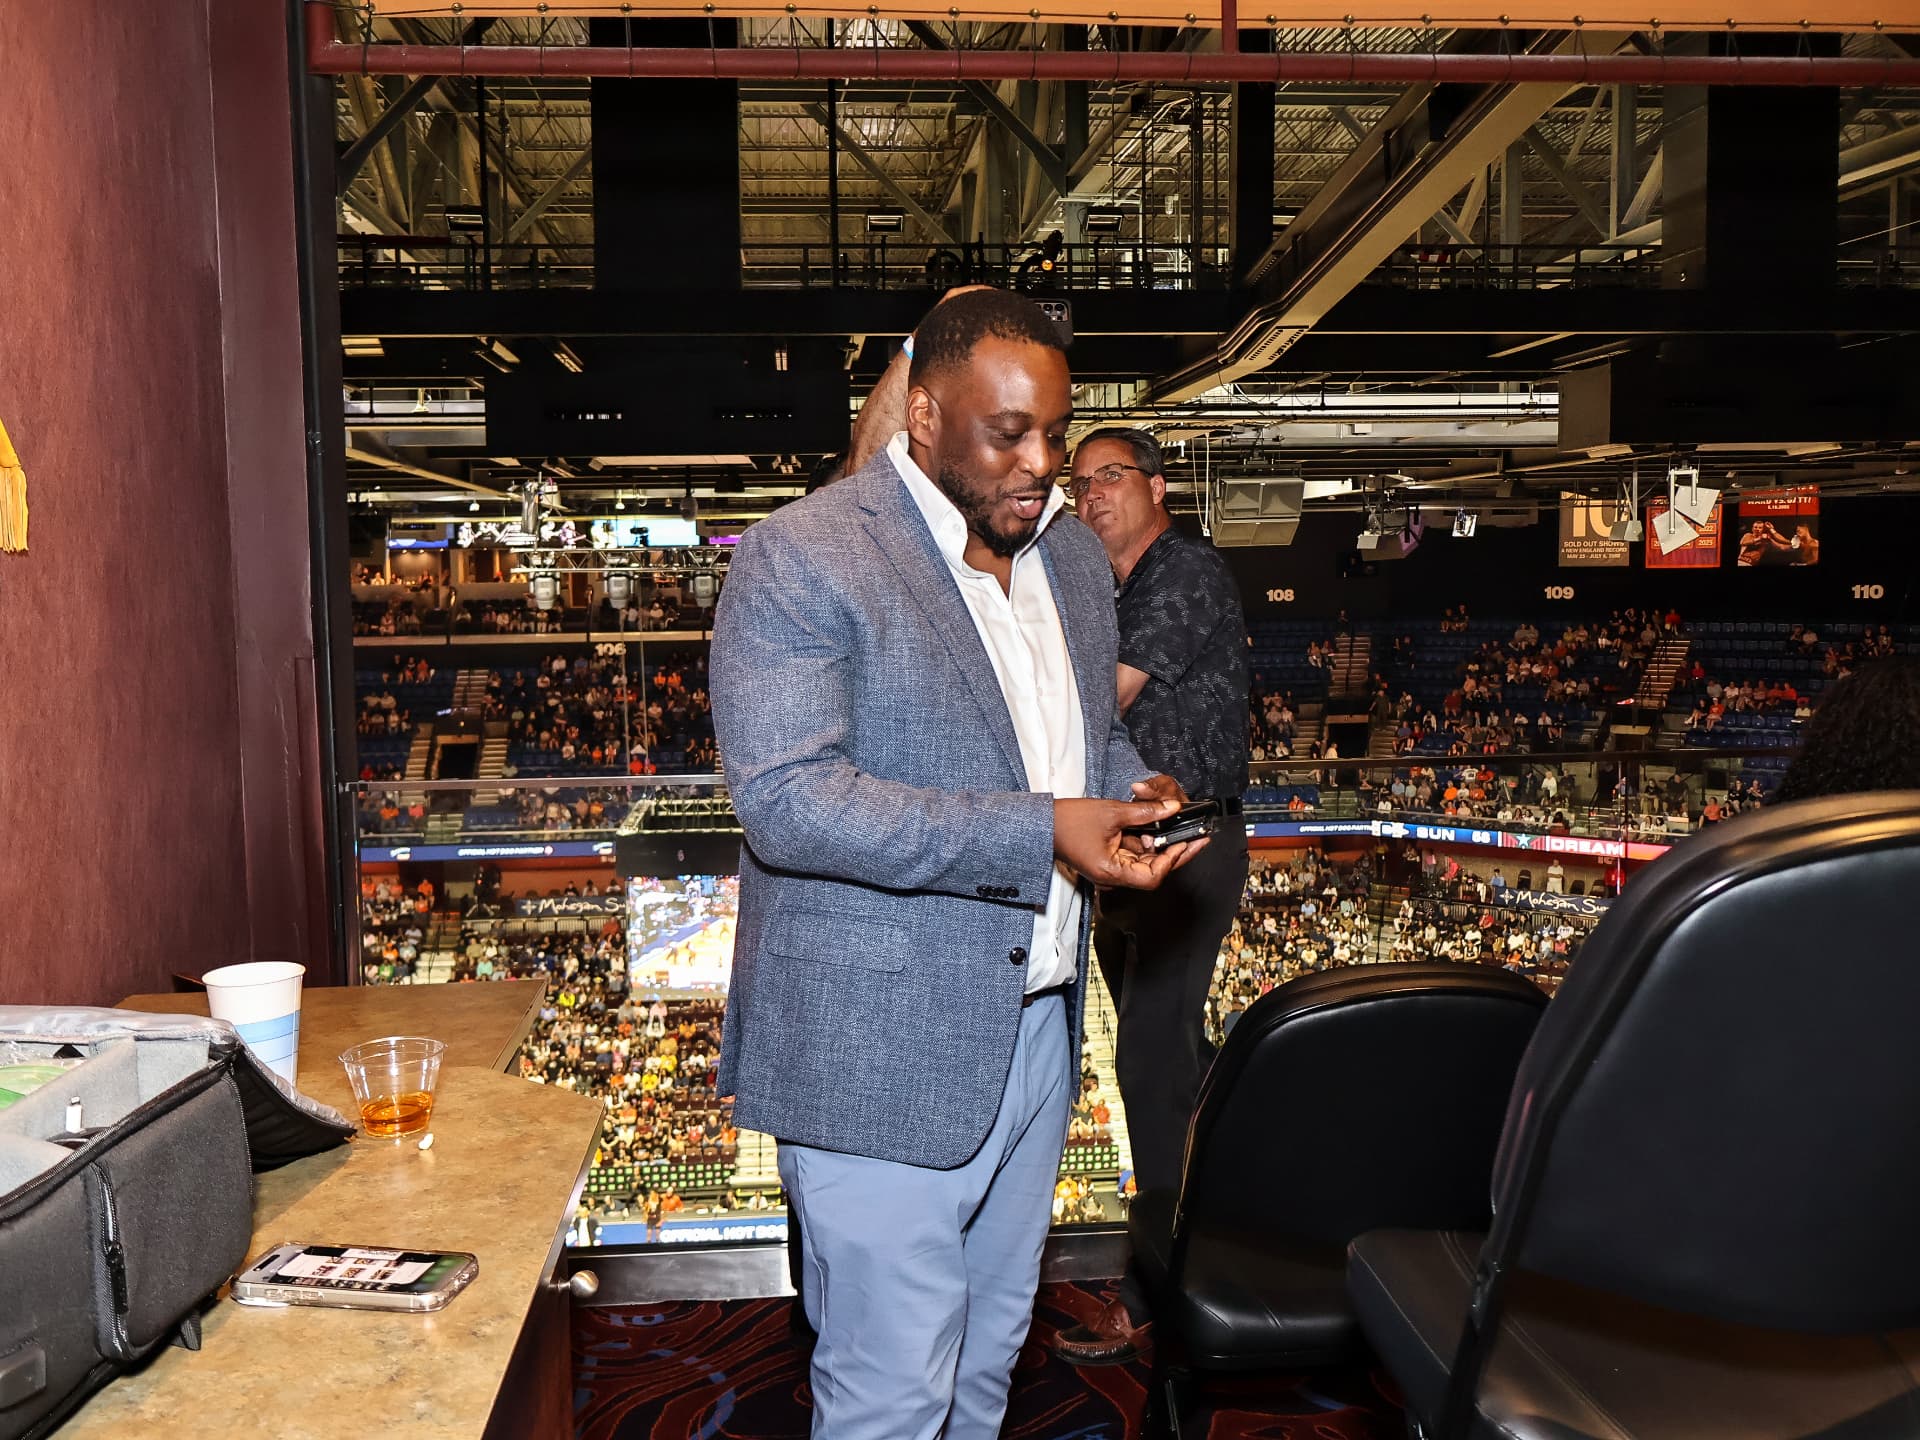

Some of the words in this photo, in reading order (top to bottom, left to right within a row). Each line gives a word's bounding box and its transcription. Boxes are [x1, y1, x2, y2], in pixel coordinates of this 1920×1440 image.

[1266, 589, 1295, 602] 108
[1544, 586, 1575, 600] 109
[1851, 584, 1884, 599] 110
[595, 643, 627, 657] 106
[1416, 826, 1455, 841] SUN
[1551, 838, 1624, 856] DREAM
[538, 897, 603, 914] Mohegan
[605, 897, 626, 913] Su
[1516, 891, 1580, 912] Mohegan
[659, 1227, 723, 1243] OFFICIAL
[724, 1226, 755, 1240] HOT
